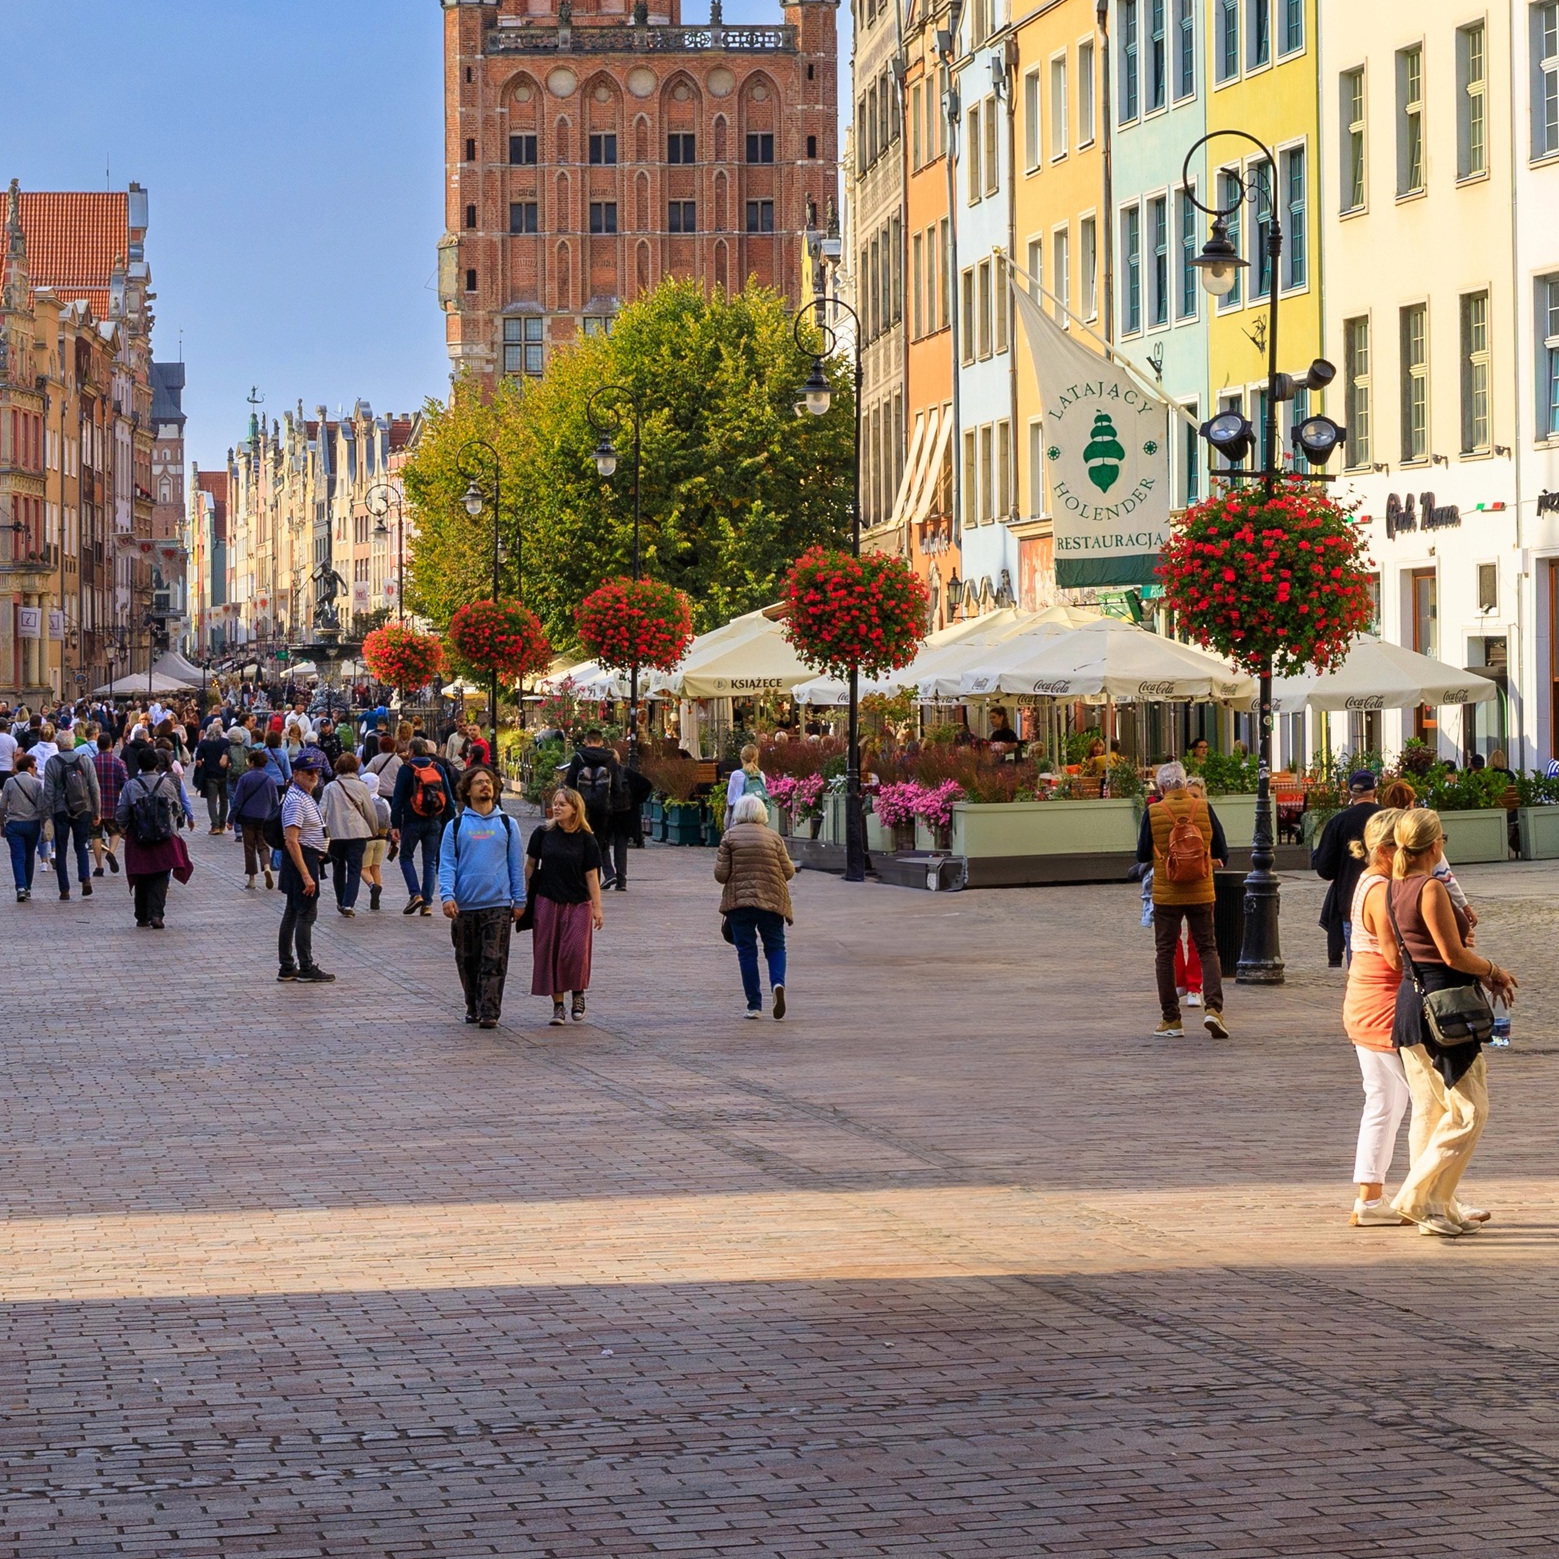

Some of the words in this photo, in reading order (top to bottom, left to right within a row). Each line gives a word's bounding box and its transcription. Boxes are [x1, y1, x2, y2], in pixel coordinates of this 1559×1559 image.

[1048, 381, 1153, 421] LATAJĄCY
[1053, 478, 1156, 521] HOLENDER
[1057, 532, 1165, 551] RESTAURACJA
[1033, 679, 1072, 694] Coca-Cola
[1138, 680, 1175, 695] Coca-Cola
[1345, 695, 1385, 709] Coca-Cola
